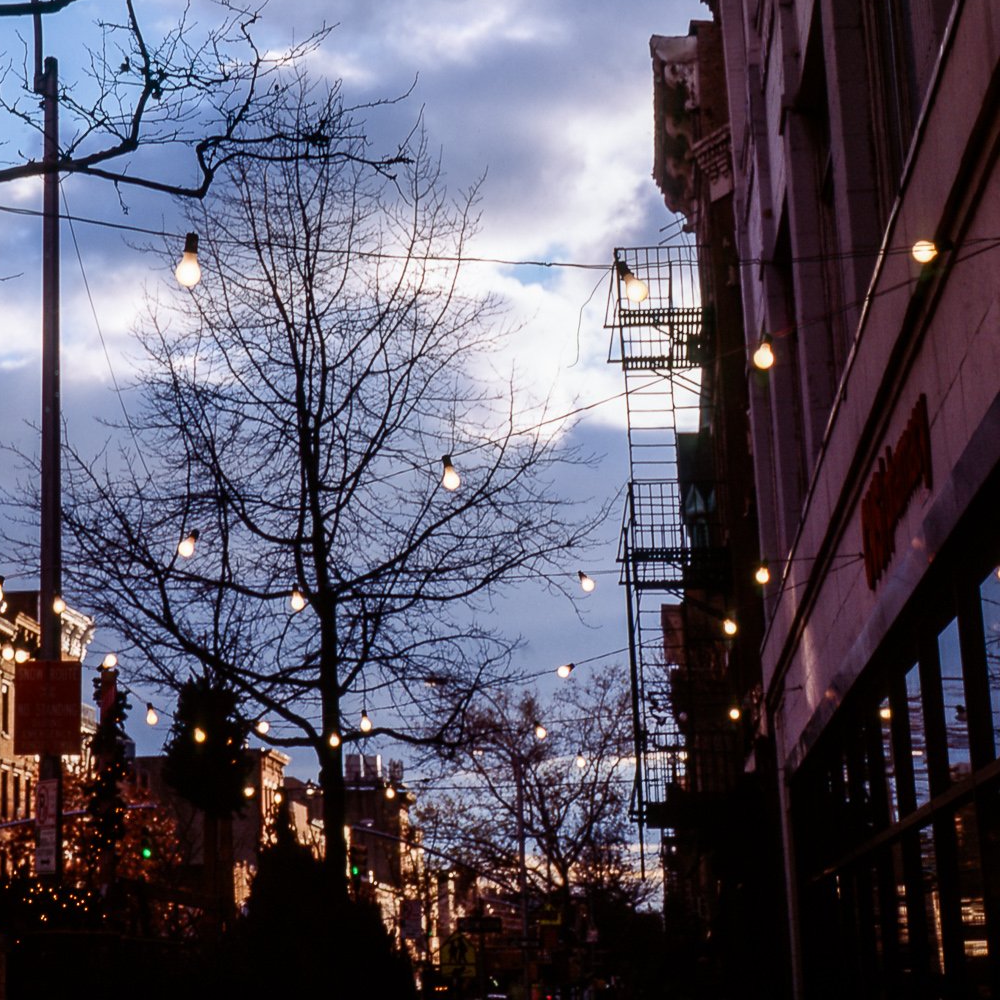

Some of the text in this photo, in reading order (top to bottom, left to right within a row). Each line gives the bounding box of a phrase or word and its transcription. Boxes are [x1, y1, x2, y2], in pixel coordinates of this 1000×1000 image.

[18, 667, 77, 681] SNOW ROUTE
[18, 703, 30, 717] NO
